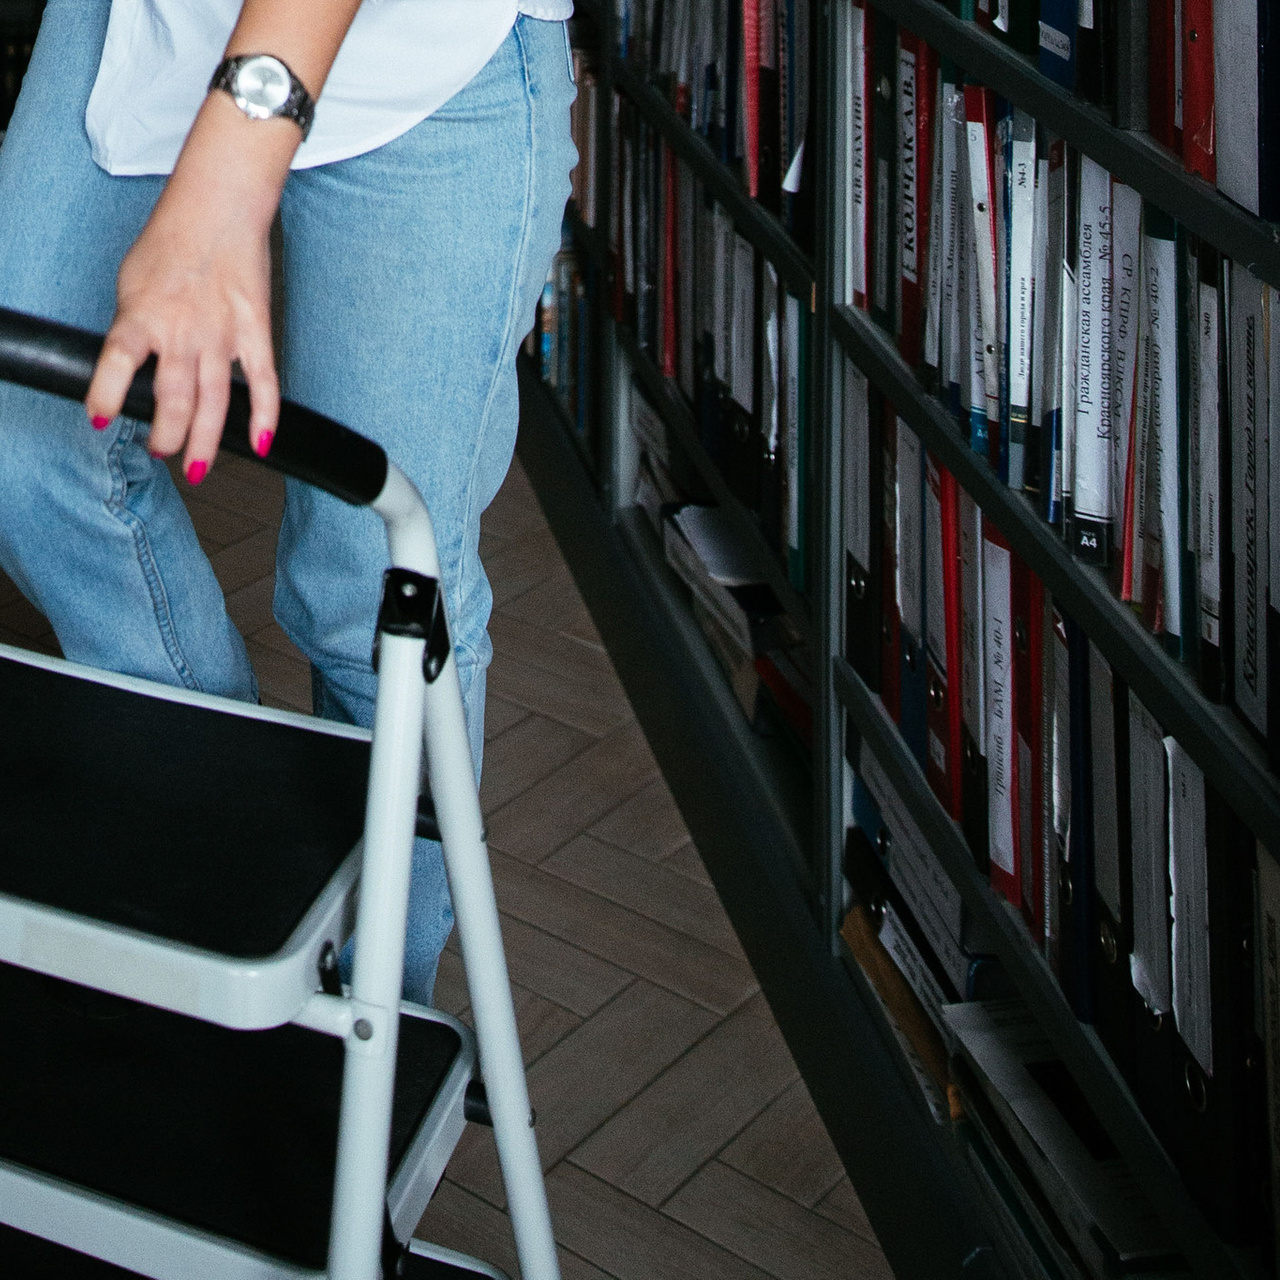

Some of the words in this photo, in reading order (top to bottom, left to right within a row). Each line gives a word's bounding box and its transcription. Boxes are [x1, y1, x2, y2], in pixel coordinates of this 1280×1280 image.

[902, 131, 915, 253] КОЛЧАК
[1098, 205, 1112, 241] 45-5
[1078, 223, 1093, 306] ассамблея
[1100, 277, 1113, 313] края
[1149, 266, 1160, 305] 40-2
[1076, 309, 1093, 415] Гражданская
[1096, 317, 1113, 441] Красноярского
[1080, 535, 1098, 549] A4
